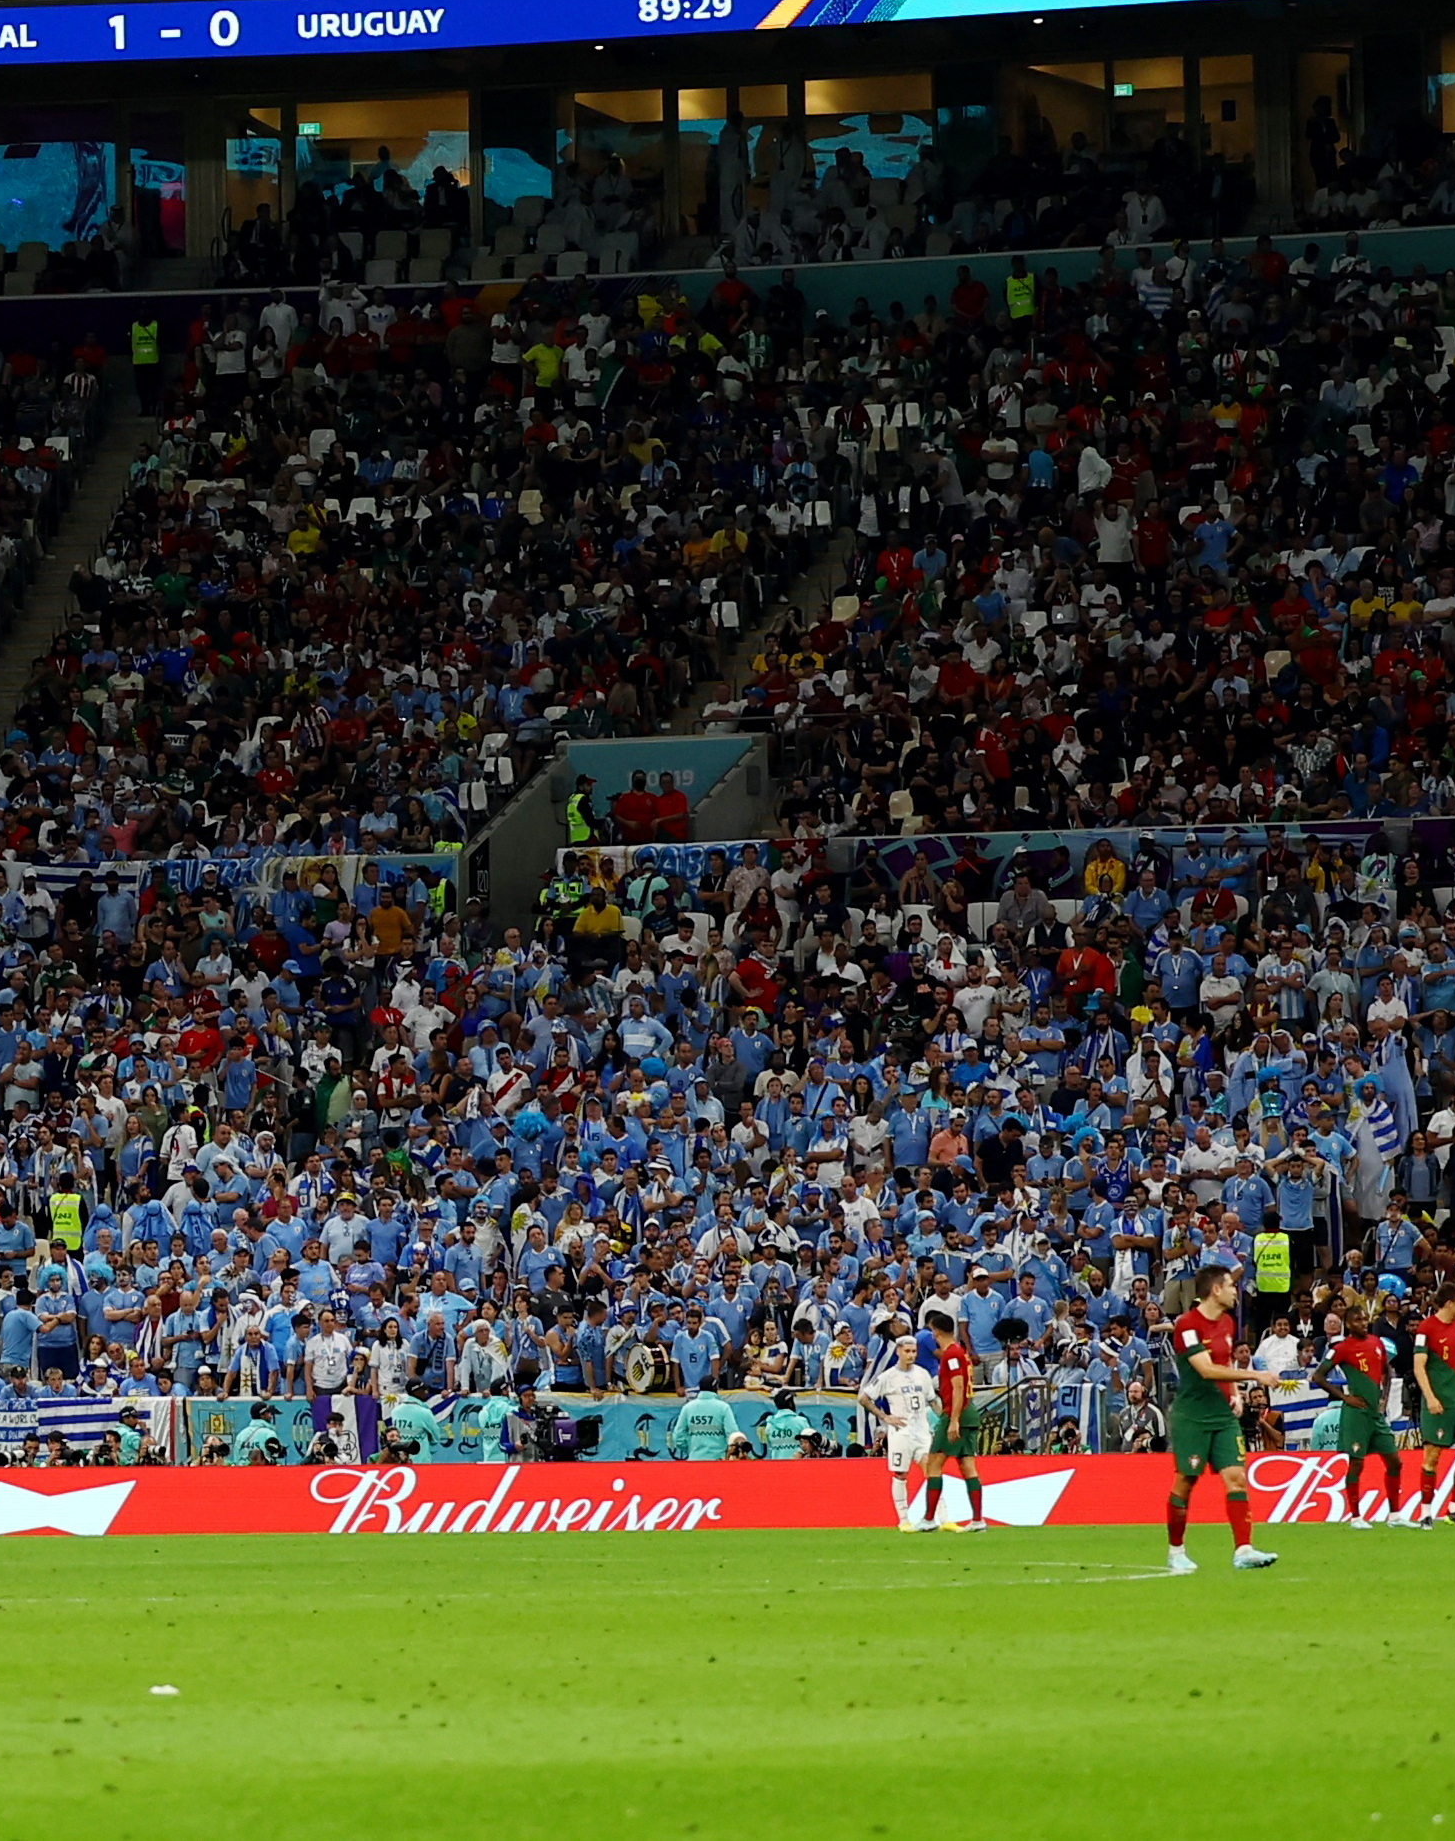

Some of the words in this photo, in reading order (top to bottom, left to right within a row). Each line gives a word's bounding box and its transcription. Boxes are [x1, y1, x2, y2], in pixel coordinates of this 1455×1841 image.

[108, 14, 126, 50] 1
[209, 10, 240, 47] 0
[297, 7, 446, 40] URUGUAY
[1358, 1358, 1369, 1372] 15
[310, 1465, 722, 1535] Budweiser
